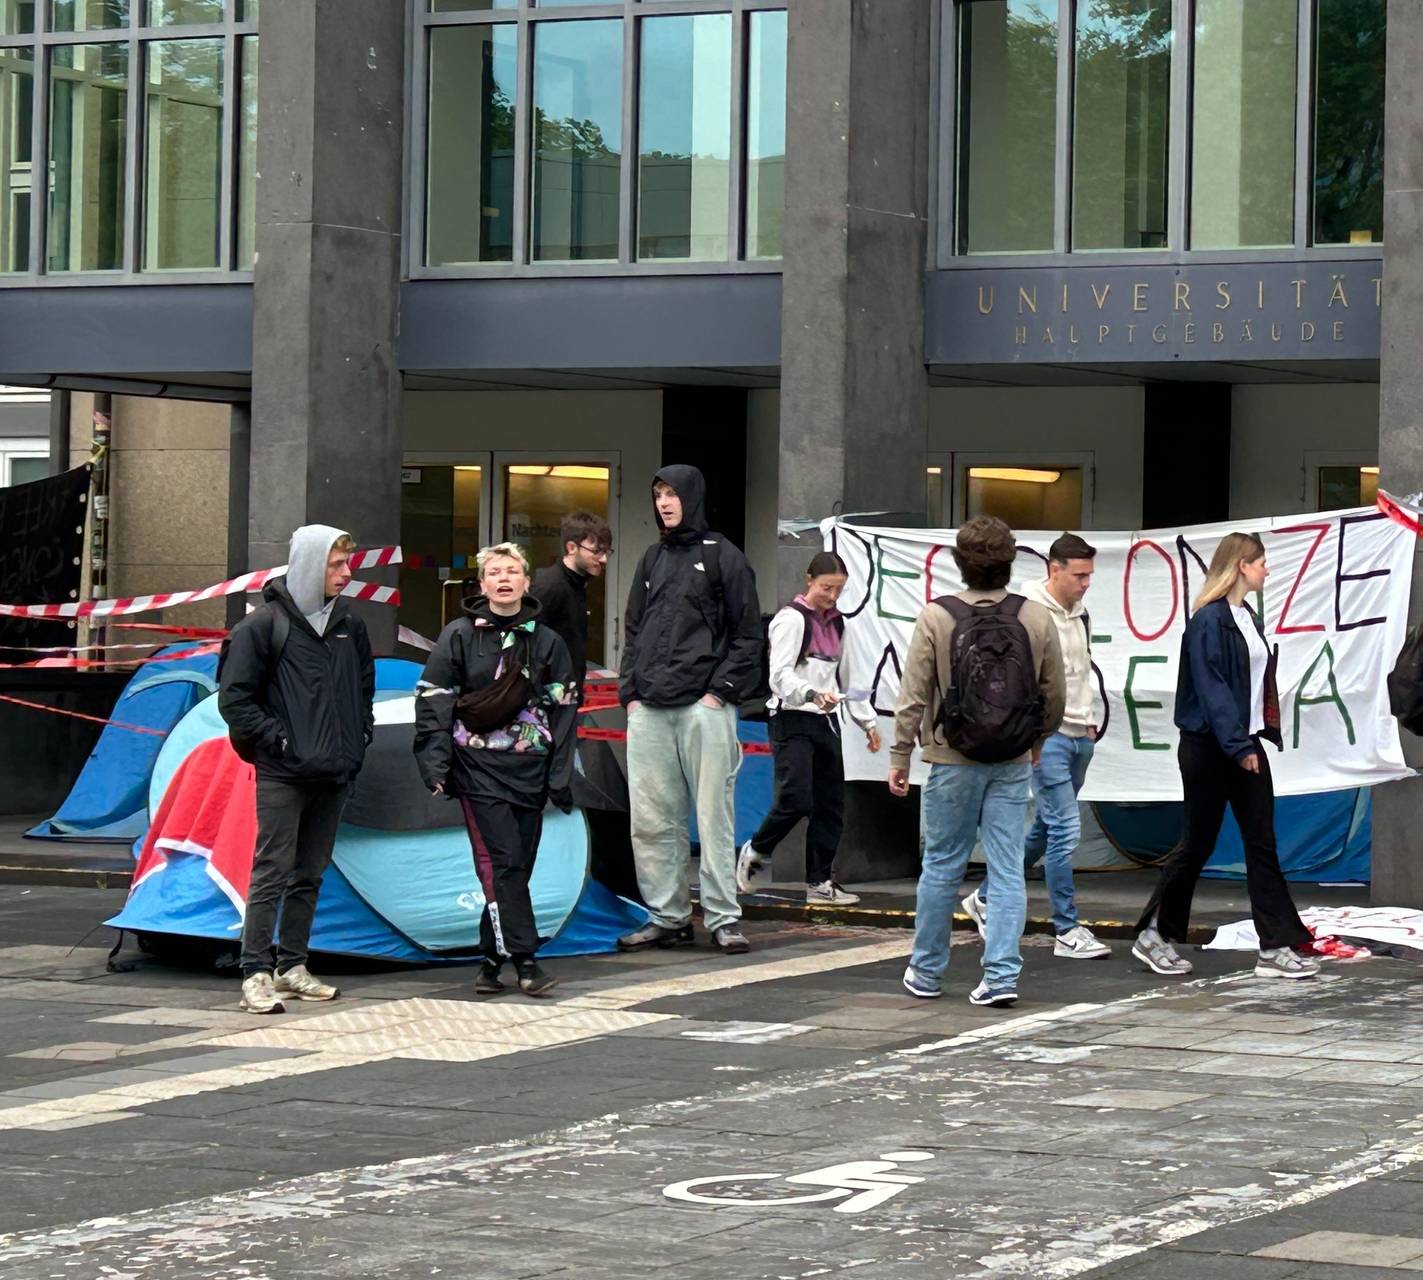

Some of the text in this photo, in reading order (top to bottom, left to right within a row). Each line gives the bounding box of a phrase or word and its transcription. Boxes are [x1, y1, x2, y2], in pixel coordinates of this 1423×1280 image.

[978, 273, 1382, 315] UNIVERSITÄT
[1014, 319, 1346, 345] HAUPTGEBÄUDE
[511, 523, 562, 538] Nachte
[830, 512, 1392, 644] DECONZE
